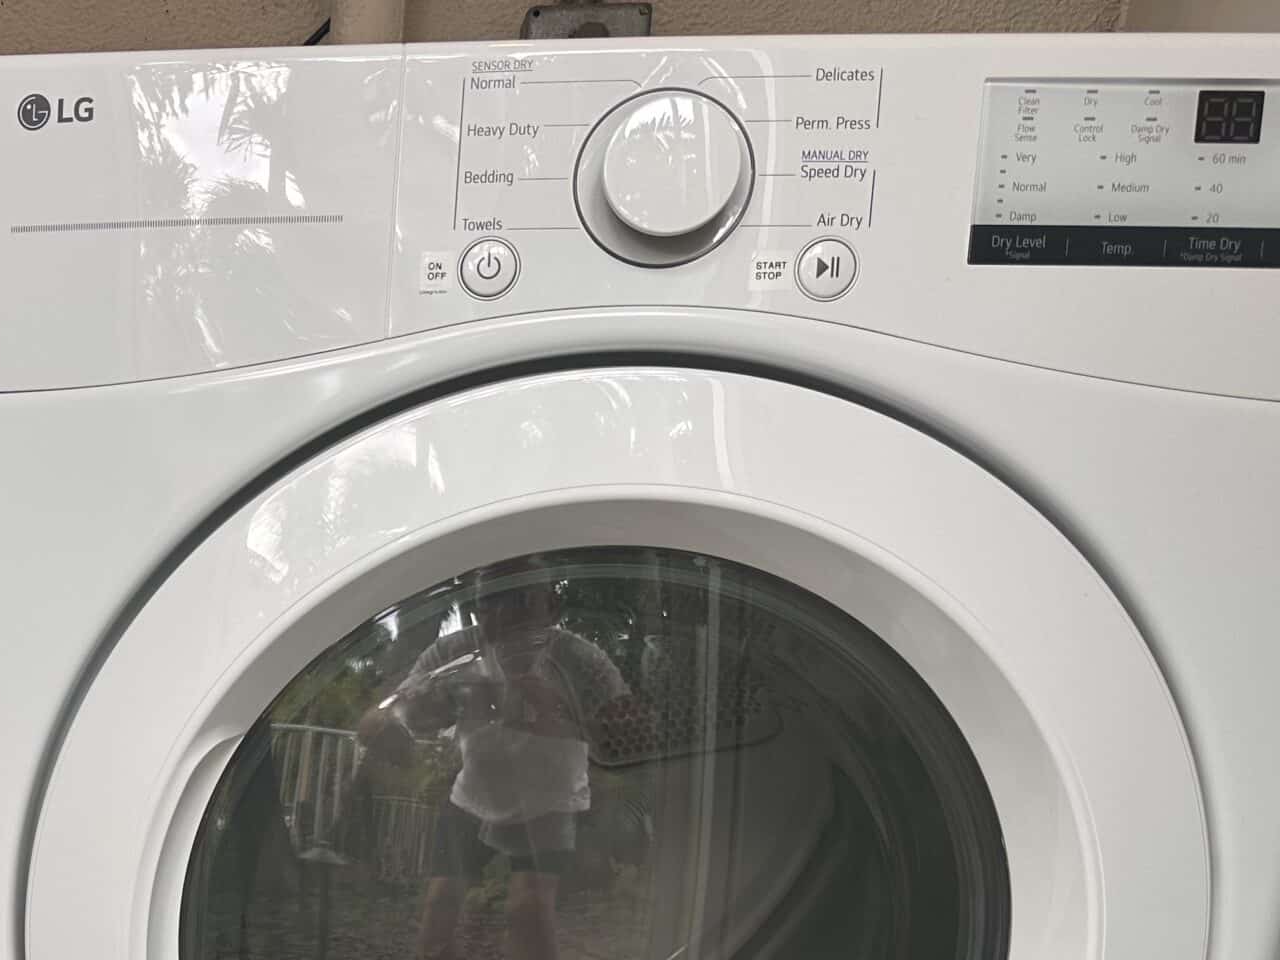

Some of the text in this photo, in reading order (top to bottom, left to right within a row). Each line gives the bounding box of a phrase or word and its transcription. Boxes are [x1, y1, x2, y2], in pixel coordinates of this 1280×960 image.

[472, 59, 533, 72] SENSOR DRY
[816, 68, 875, 82] Delicates
[470, 76, 516, 89] Normal
[1018, 97, 1040, 106] Clean
[1084, 97, 1098, 108] Dry
[1144, 97, 1162, 106] Cool
[57, 97, 94, 123] LG
[1018, 106, 1039, 114] Filter
[795, 117, 871, 131] Perm. Press
[1017, 124, 1035, 132] Flow
[1074, 124, 1103, 133] Control
[1131, 125, 1169, 134] Damp Dry
[467, 123, 539, 138] Heavy Duty
[1015, 133, 1037, 142] Sense
[1078, 134, 1096, 142] Lock
[1138, 135, 1162, 144] Signal
[802, 150, 869, 161] MANUAL DRY
[1016, 152, 1036, 164] Very
[1115, 152, 1137, 165] High
[1212, 153, 1247, 164] 60 min
[800, 165, 867, 181] Speed Dry
[464, 171, 514, 187] Bedding
[1012, 182, 1047, 192] Normal
[1111, 182, 1150, 193] Medium
[1209, 184, 1223, 194] 40
[817, 214, 863, 230] Air Dry
[1009, 211, 1037, 223] Damp
[1108, 213, 1127, 223] Low
[1206, 213, 1219, 223] 20
[462, 218, 502, 231] Towels
[991, 235, 1046, 250] Dry Level
[1189, 237, 1241, 253] Time Dry
[428, 262, 442, 270] ON
[756, 261, 787, 271] START
[427, 272, 446, 280] OFF
[756, 271, 781, 280] STOP
